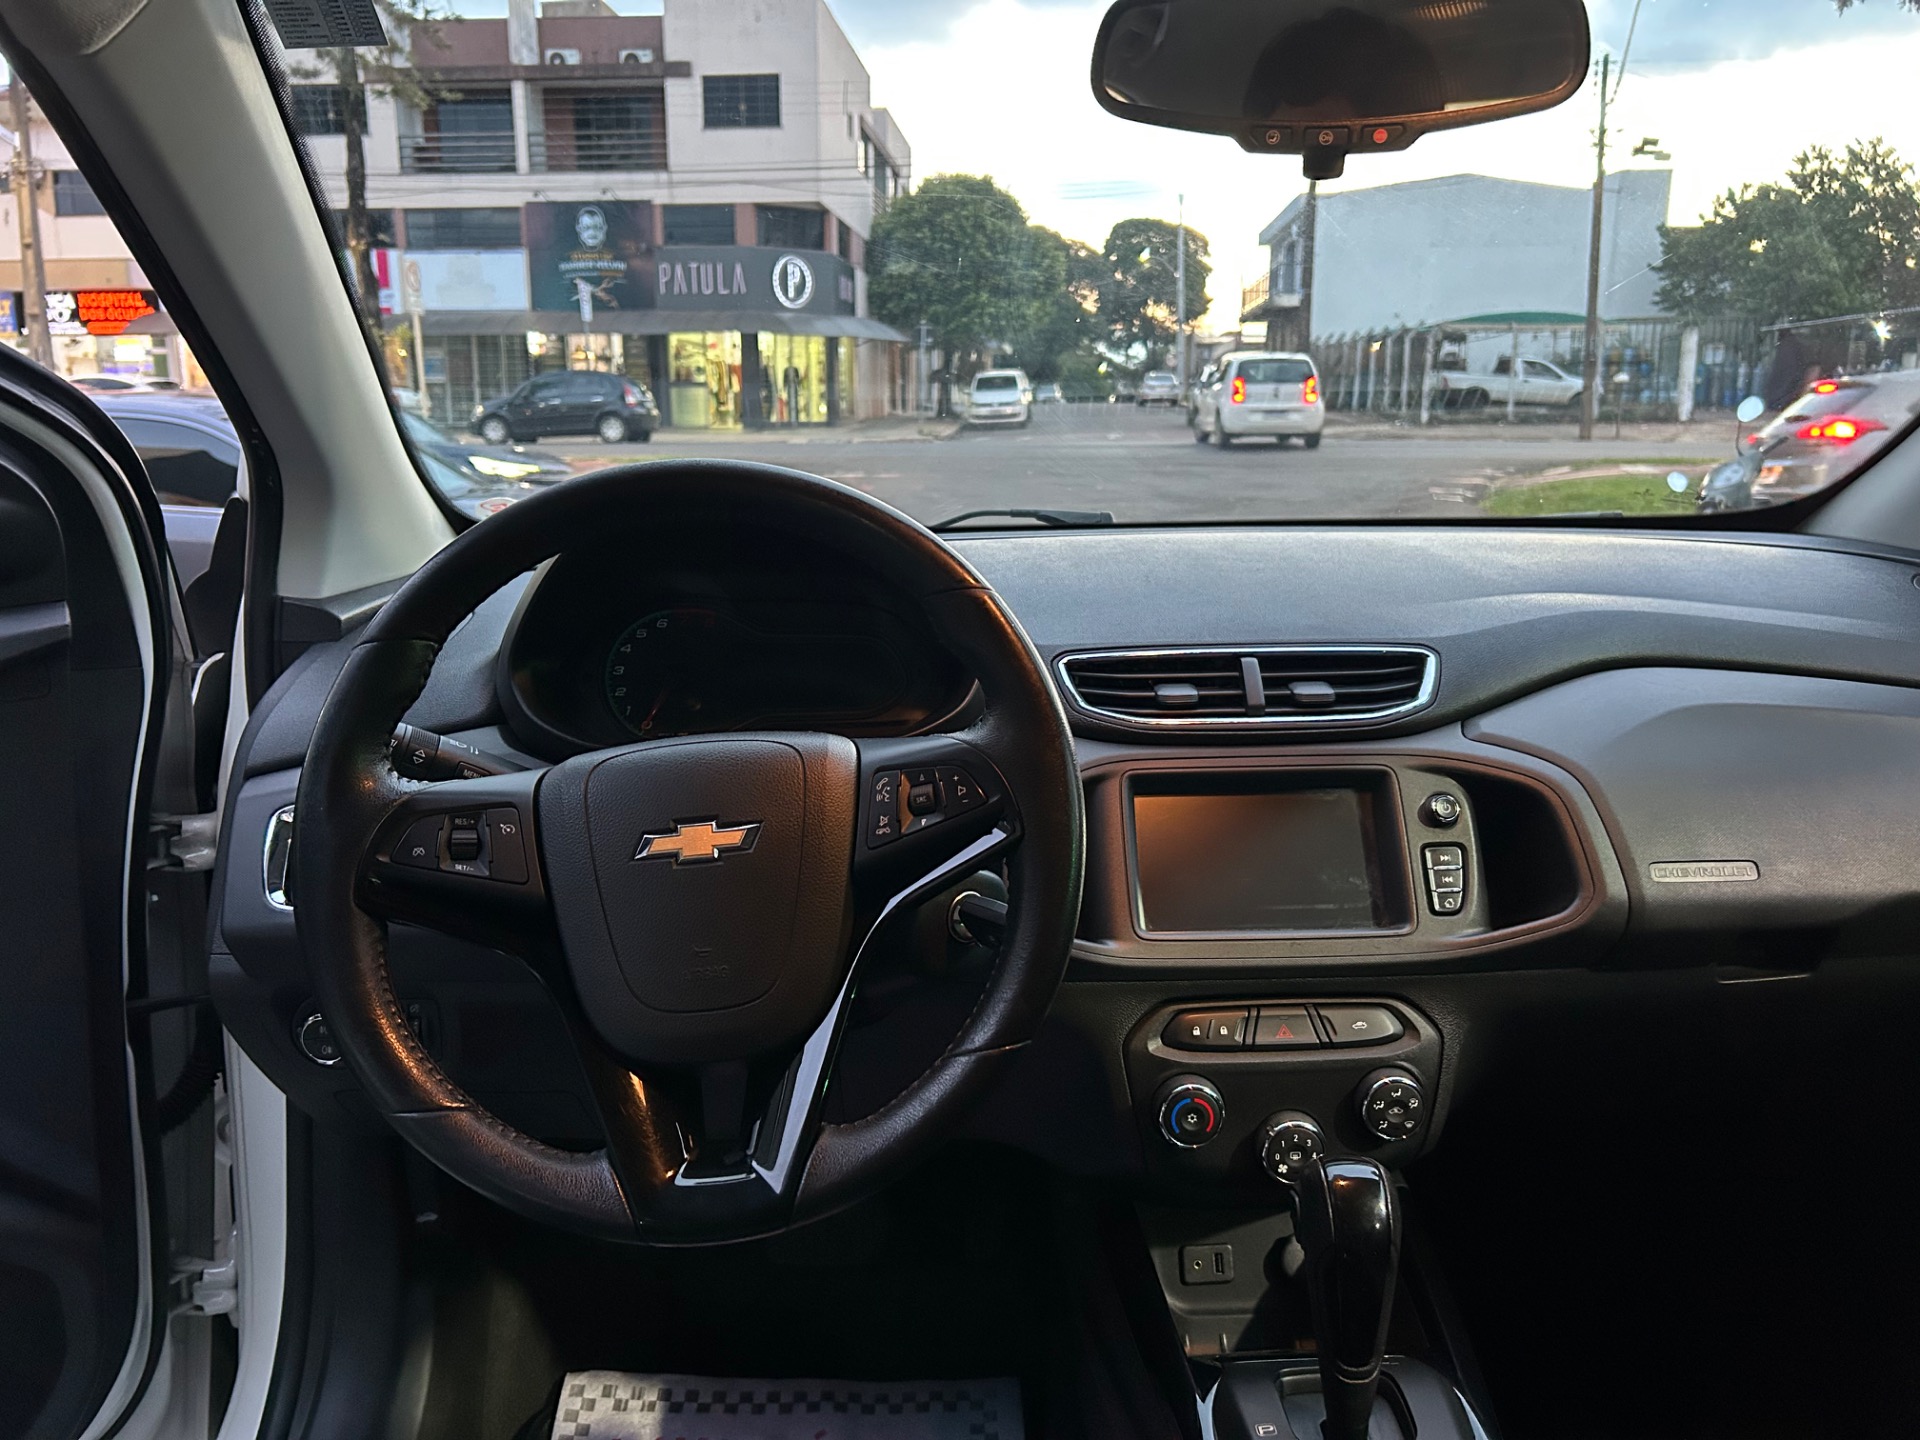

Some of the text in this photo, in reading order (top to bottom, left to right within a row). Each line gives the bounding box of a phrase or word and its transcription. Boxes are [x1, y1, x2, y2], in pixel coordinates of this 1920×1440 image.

[658, 262, 748, 296] PATULA
[77, 291, 147, 308] HOSPITAL
[656, 619, 668, 628] 6
[636, 629, 647, 638] 5
[620, 644, 631, 653] 4
[613, 666, 625, 675] 3
[615, 687, 626, 696] 2
[1653, 865, 1753, 878] CHEVROLET
